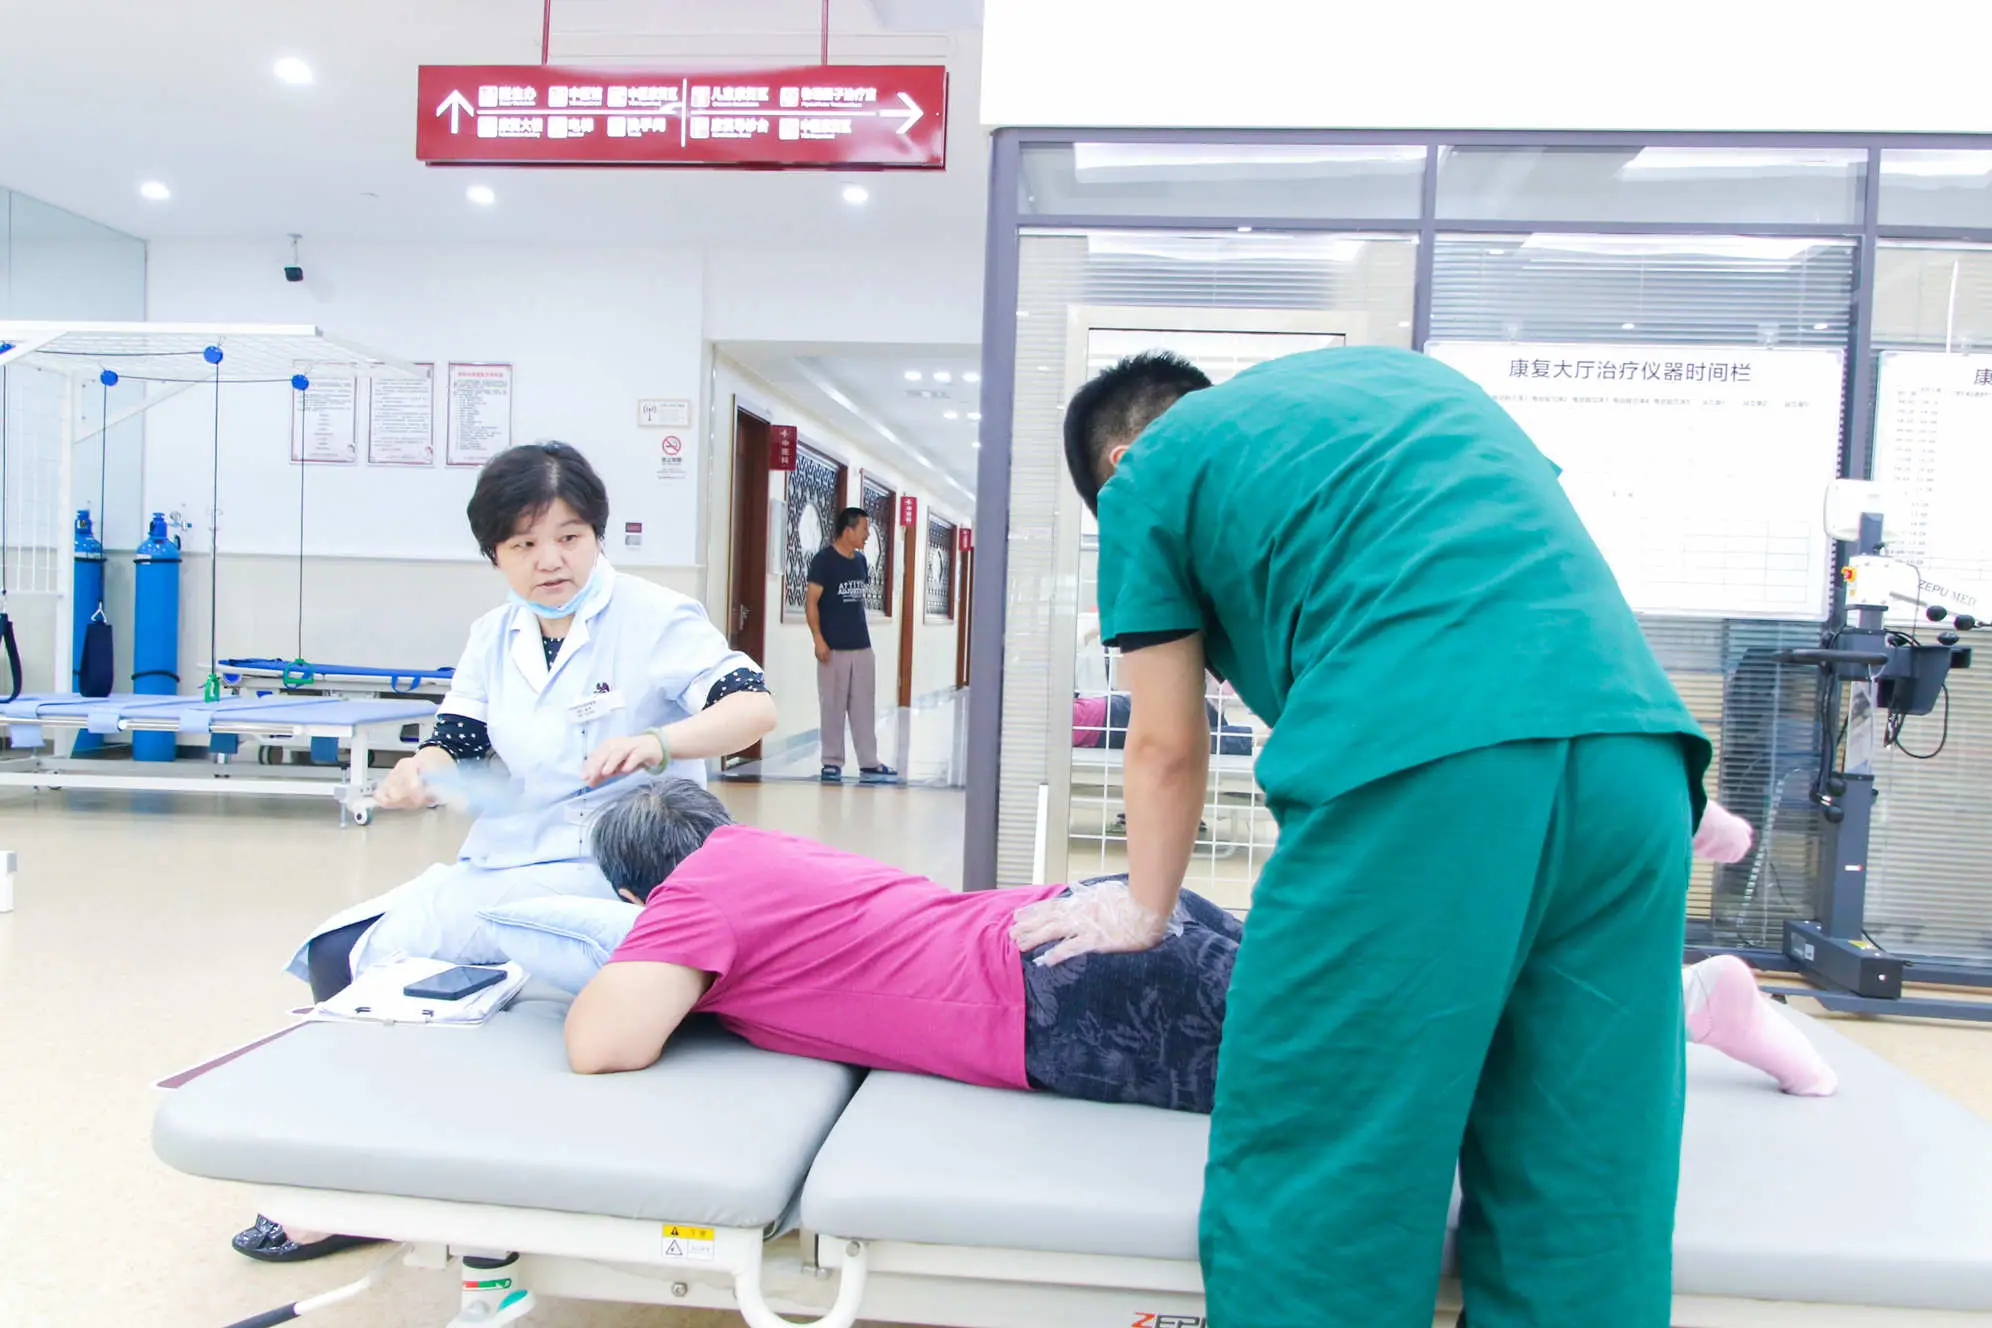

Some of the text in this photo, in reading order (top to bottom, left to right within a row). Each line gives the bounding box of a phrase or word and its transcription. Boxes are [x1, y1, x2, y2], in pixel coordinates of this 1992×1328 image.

[1509, 358, 1752, 383] 康复大厅治疗仪器时间栏
[1919, 579, 1949, 597] ZEPU
[1131, 1311, 1207, 1328] ZEP
